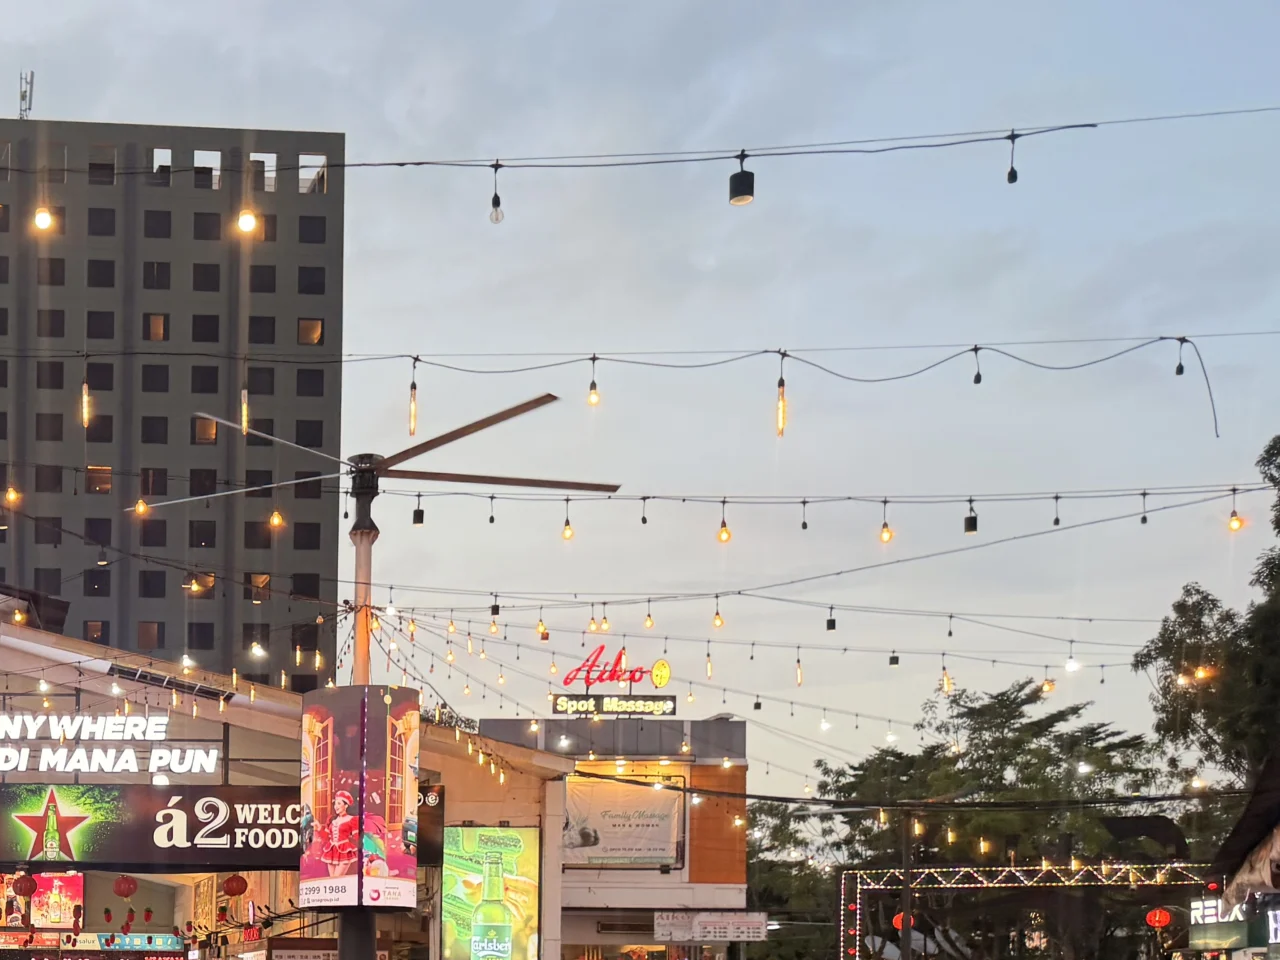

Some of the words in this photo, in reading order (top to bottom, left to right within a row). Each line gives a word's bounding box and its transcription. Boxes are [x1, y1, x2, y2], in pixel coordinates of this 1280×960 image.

[556, 696, 596, 714] Spot
[602, 697, 674, 715] Massage
[38, 748, 139, 773] MANA
[148, 748, 218, 773] PUN
[234, 828, 301, 849] FOOD
[323, 885, 347, 894] 1988
